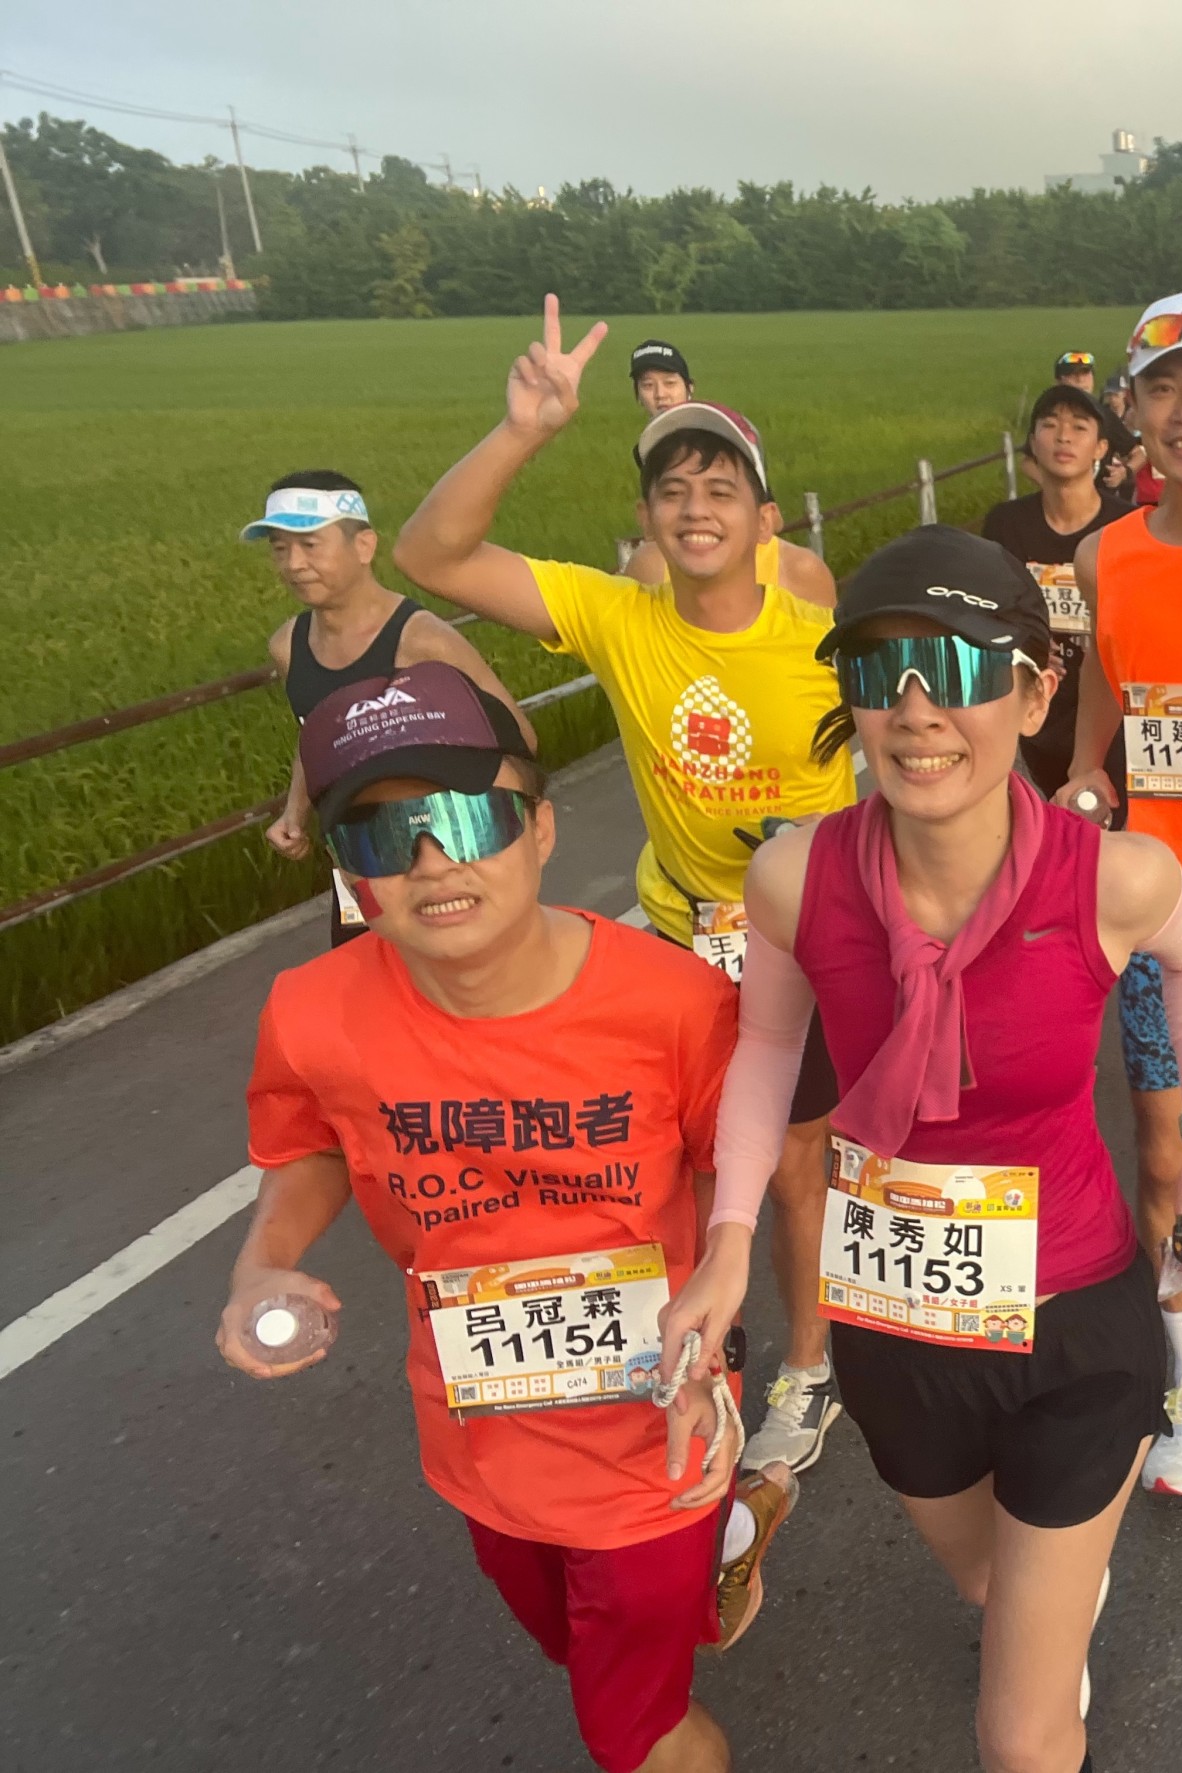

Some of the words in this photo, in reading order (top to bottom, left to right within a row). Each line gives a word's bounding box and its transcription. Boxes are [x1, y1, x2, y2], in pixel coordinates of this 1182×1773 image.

[926, 586, 998, 610] orca
[345, 686, 417, 720] LAVA
[426, 711, 446, 720] BAY
[378, 1090, 634, 1155] 視障跑者
[388, 1167, 484, 1199] R.O.C
[505, 1162, 640, 1190] Visually
[843, 1200, 983, 1257] 陳秀如
[844, 1241, 984, 1296] 11153
[1000, 1285, 1012, 1293] XS
[465, 1287, 624, 1337] 呂冠霖
[470, 1320, 627, 1367] 11154
[567, 1377, 588, 1389] C474
